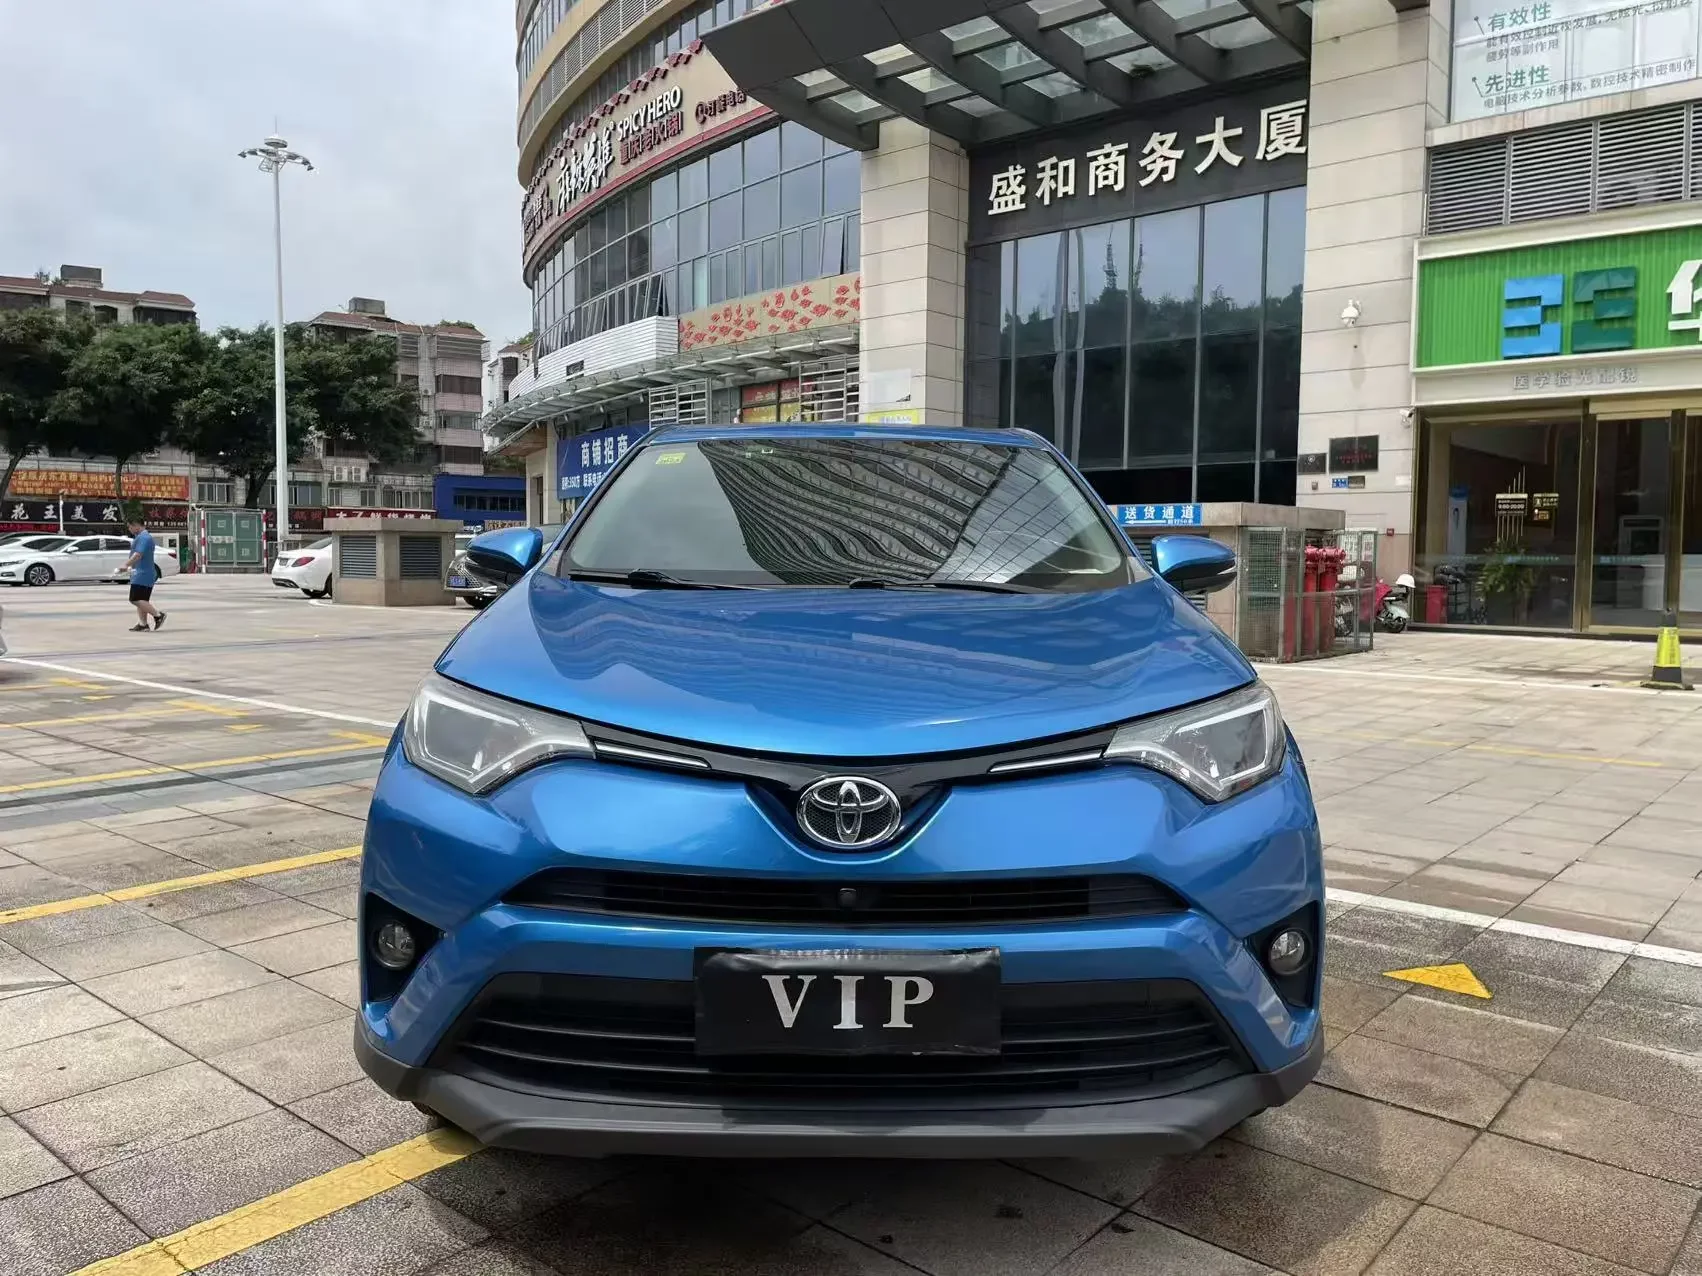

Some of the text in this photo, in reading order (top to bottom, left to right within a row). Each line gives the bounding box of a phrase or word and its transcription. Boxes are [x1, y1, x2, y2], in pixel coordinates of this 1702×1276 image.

[1488, 2, 1551, 32] 有效性
[1485, 65, 1550, 94] 先进性
[617, 86, 682, 141] SPICY HERO
[988, 99, 1308, 215] 盛和商务大厦
[581, 433, 628, 468] 商铺招商
[11, 502, 118, 522] 花王美发
[1125, 504, 1194, 519] 送货通道
[762, 974, 934, 1030] VIP
